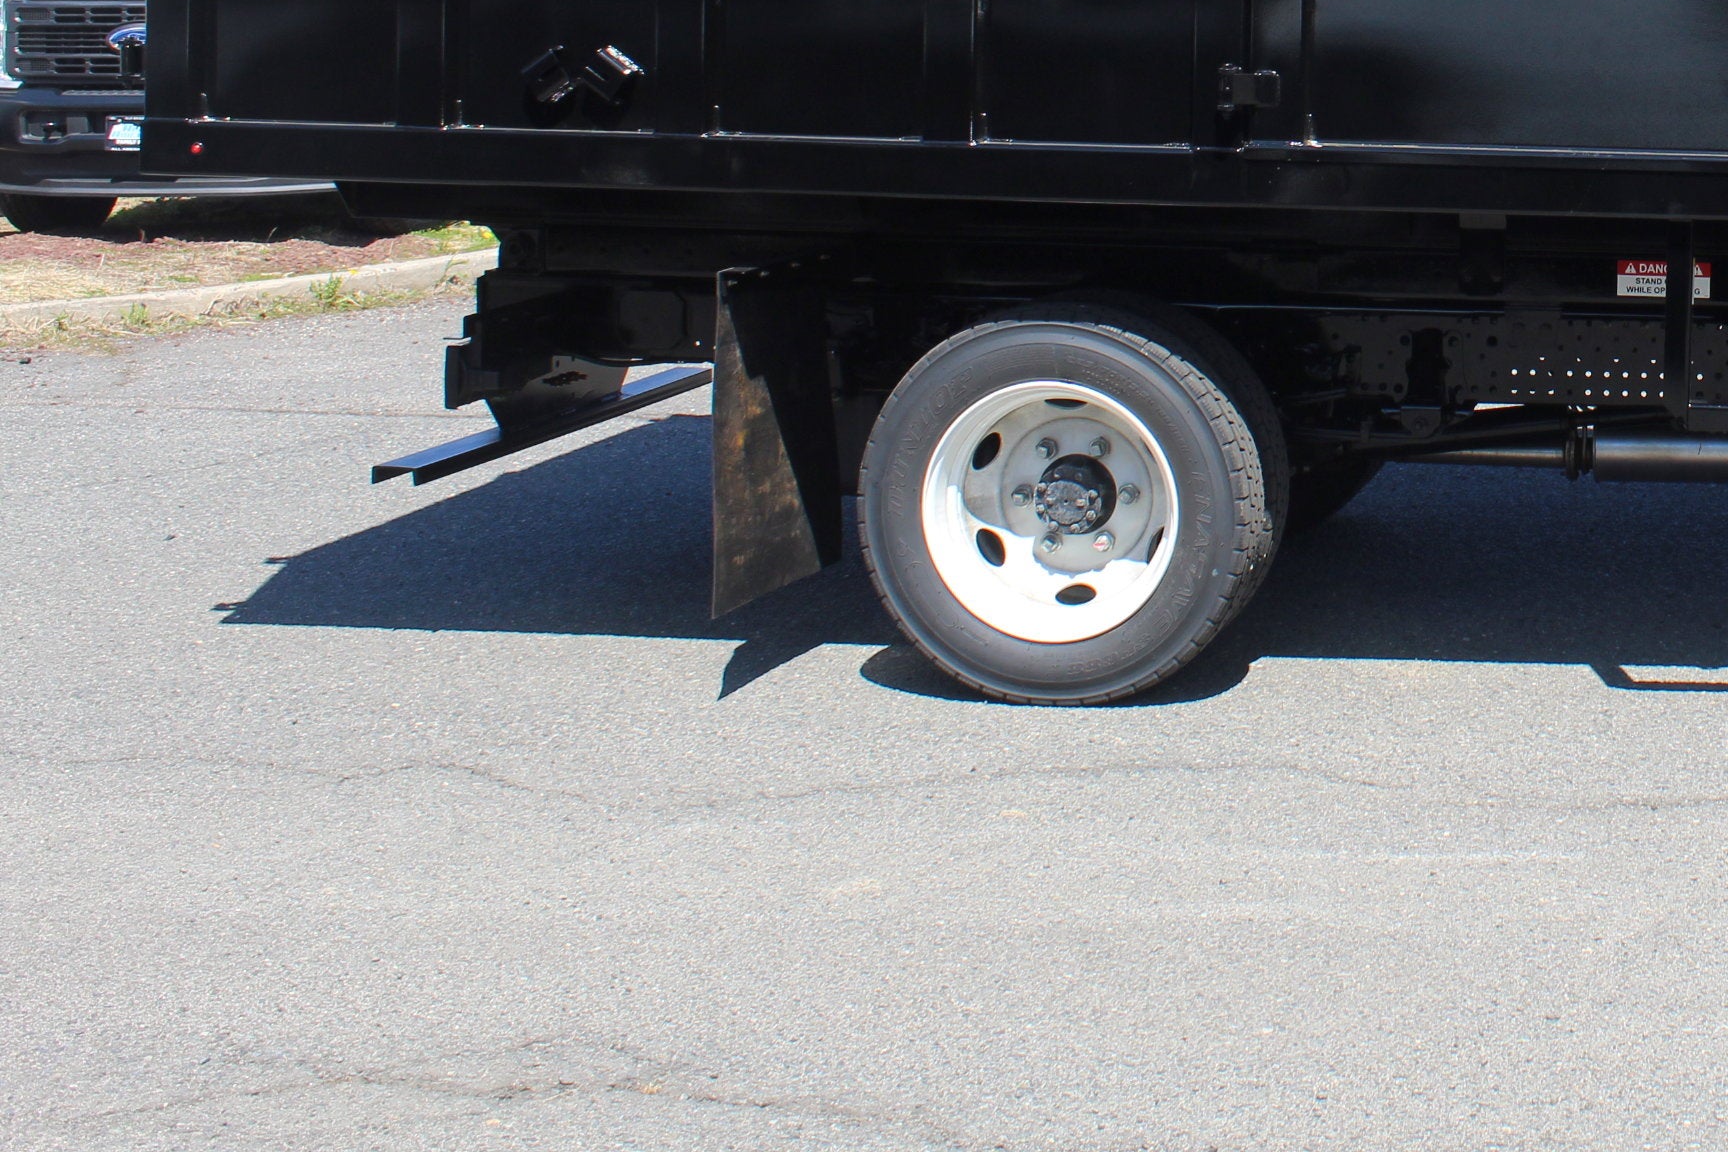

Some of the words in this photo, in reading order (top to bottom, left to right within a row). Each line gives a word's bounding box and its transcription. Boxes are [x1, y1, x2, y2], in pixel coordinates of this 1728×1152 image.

[1639, 263, 1667, 274] DAN
[1635, 277, 1662, 285] STAND
[1626, 286, 1652, 294] WHILE
